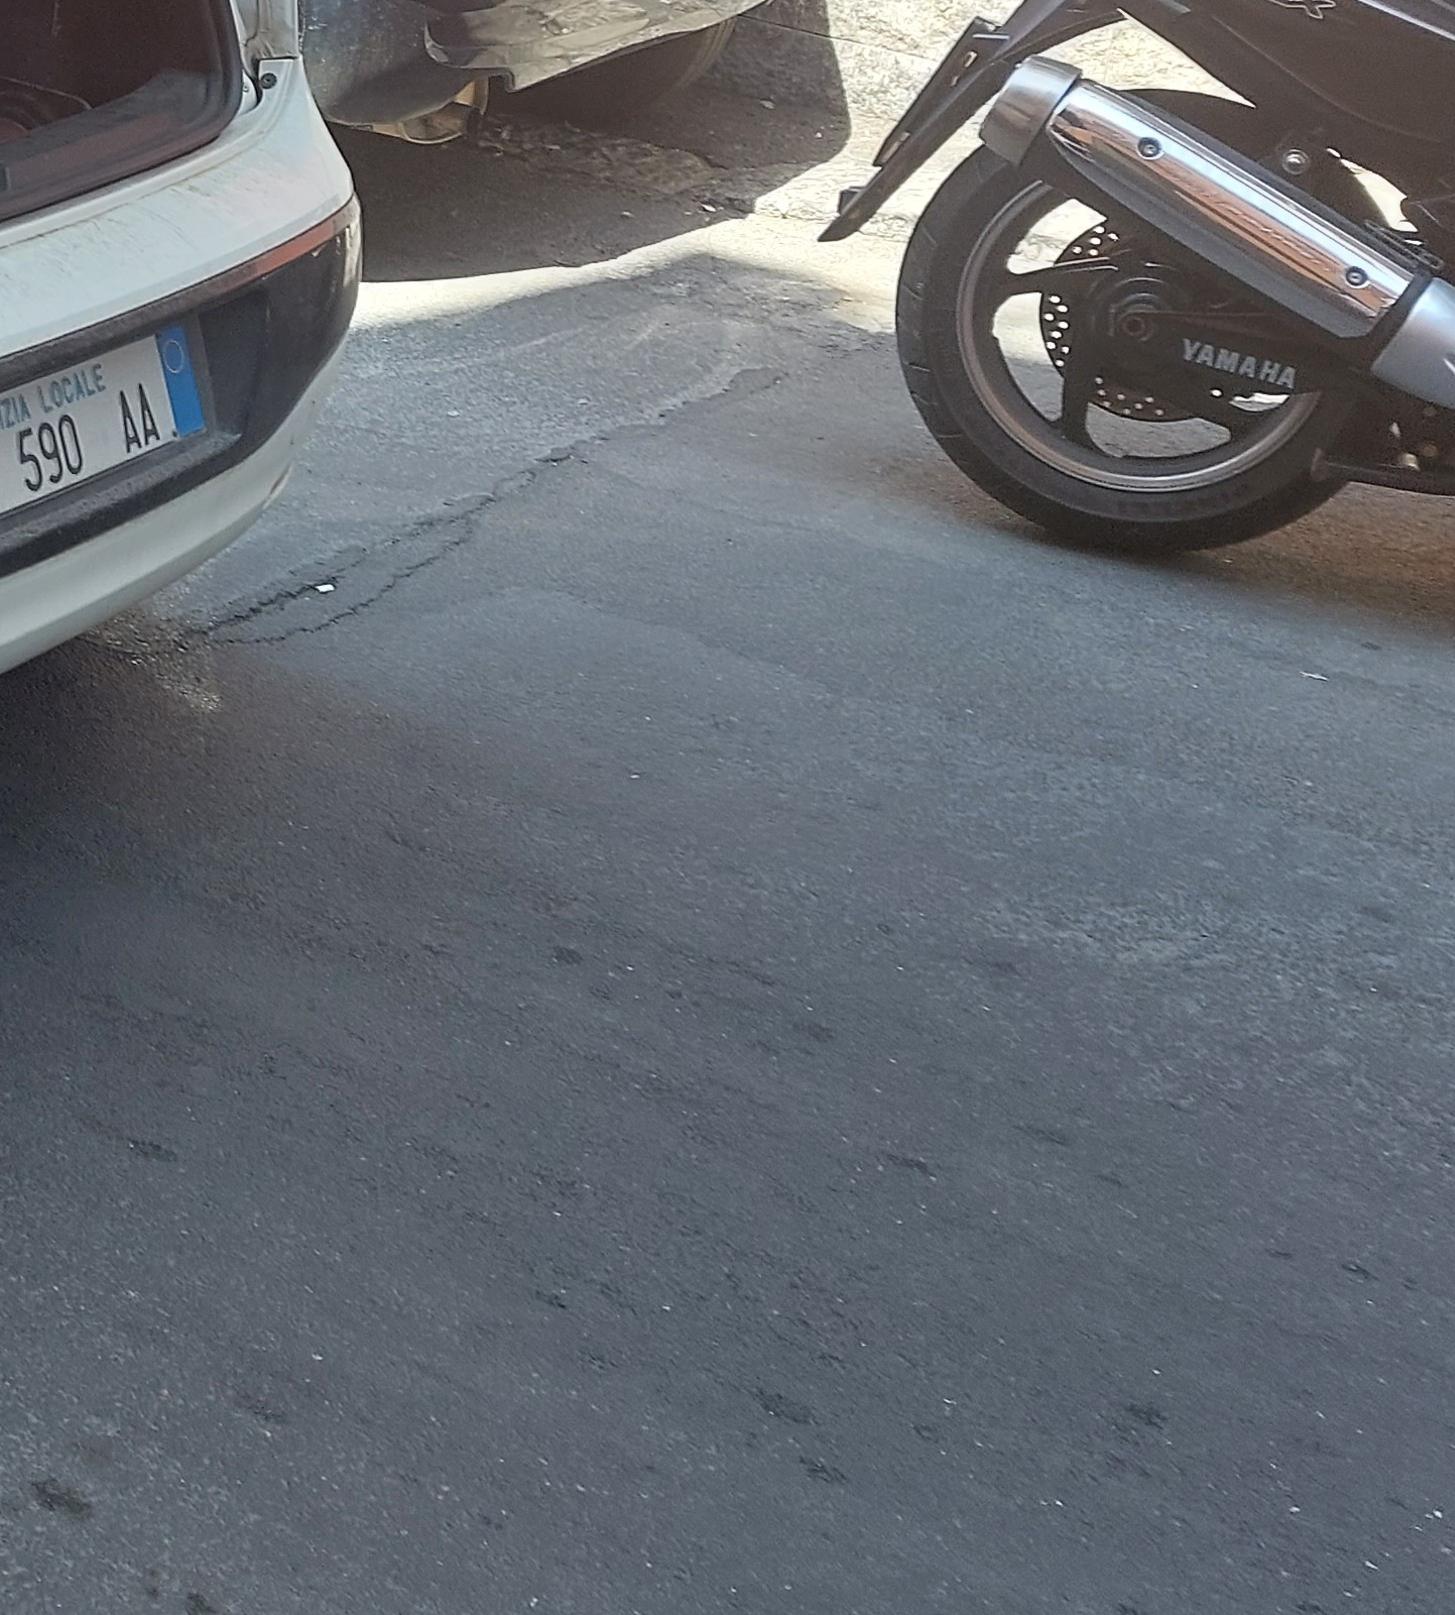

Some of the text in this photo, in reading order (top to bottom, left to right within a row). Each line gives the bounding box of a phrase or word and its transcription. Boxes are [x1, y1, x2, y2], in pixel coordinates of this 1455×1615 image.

[36, 363, 107, 414] LOCALE
[1183, 338, 1297, 389] YAMAHA
[15, 413, 84, 493] 590
[119, 382, 161, 454] AA
